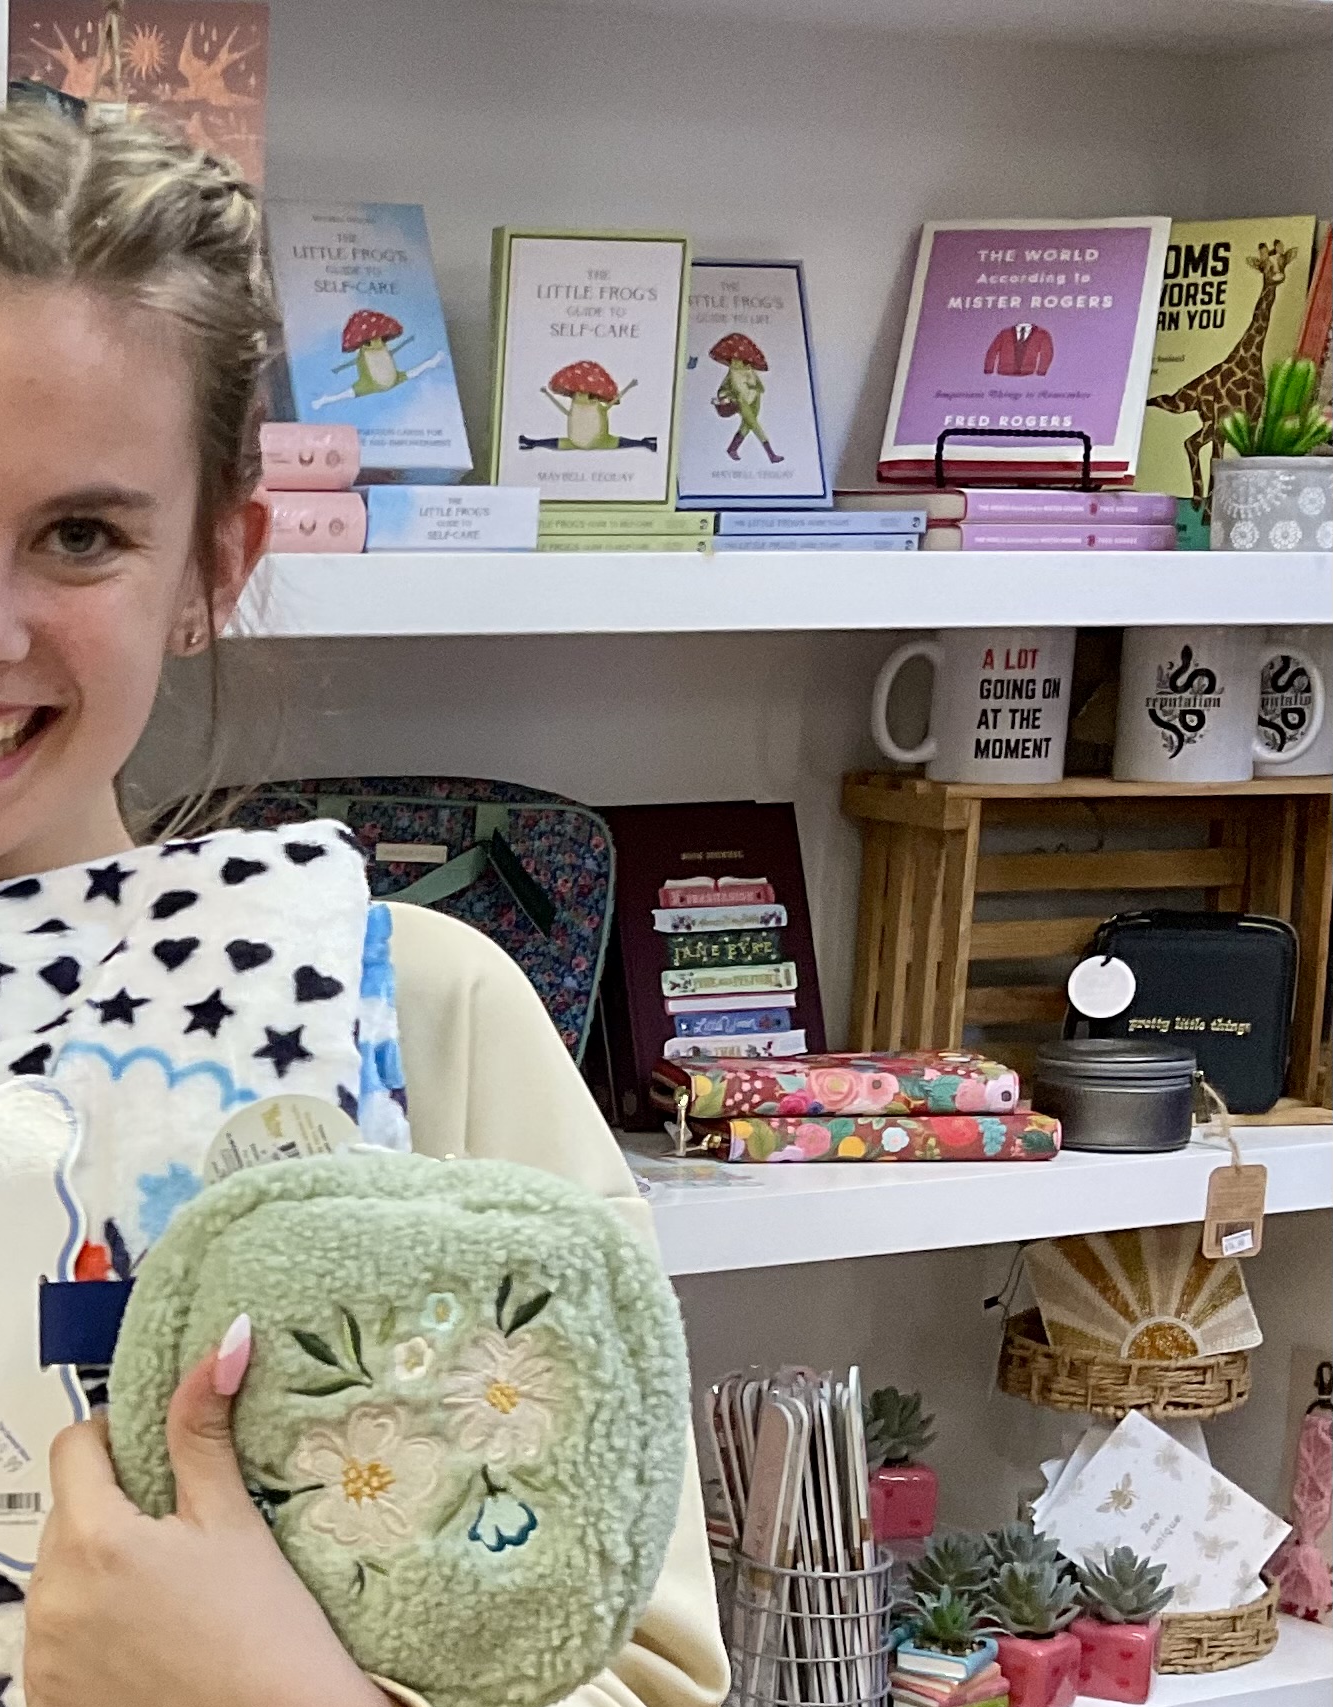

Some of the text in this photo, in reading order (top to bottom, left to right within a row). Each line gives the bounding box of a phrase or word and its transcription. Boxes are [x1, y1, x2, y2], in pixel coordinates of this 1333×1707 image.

[292, 246, 347, 262] LITTLE
[977, 249, 1101, 263] THE WORLD
[1163, 242, 1231, 280] OMS
[314, 279, 399, 296] SELF-CARE
[976, 272, 1092, 286] According to
[536, 284, 658, 301] LITTLE FROG'S
[947, 295, 1115, 310] MISTER ROGERS
[1187, 309, 1225, 331] YOU
[550, 323, 641, 338] SELF-CARE
[943, 415, 1074, 428] FRED ROGERS
[981, 648, 1040, 670] A LOT
[979, 677, 1062, 700] GOING ON
[1145, 695, 1222, 709] reputation
[976, 708, 1043, 730] AT THE
[974, 737, 1053, 760] MOMENT
[673, 940, 774, 966] JANE EYRE
[1127, 1015, 1253, 1036] pretty little things
